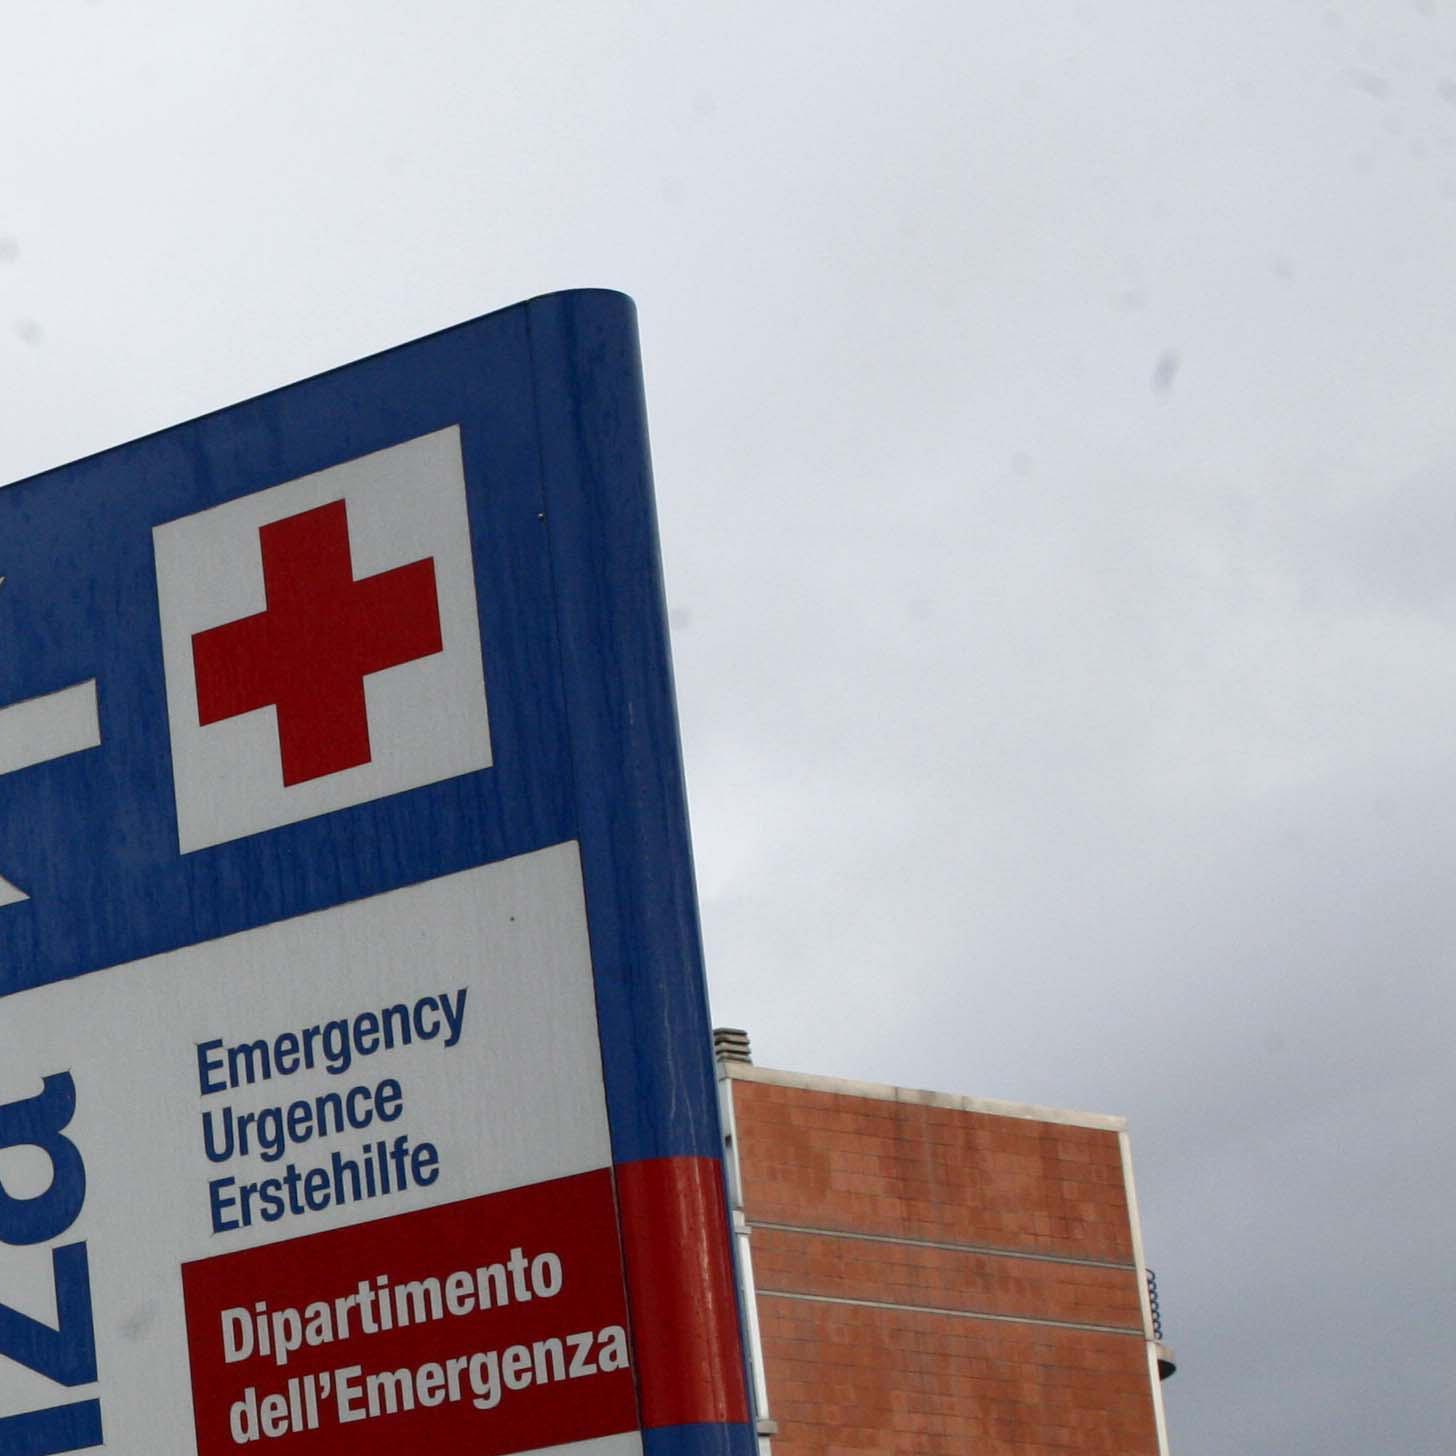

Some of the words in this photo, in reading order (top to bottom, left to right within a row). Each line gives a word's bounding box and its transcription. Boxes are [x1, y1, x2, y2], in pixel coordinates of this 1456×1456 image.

[197, 987, 468, 1095] Emergency
[201, 1077, 404, 1163] Urgence
[208, 1134, 440, 1234] Erstehilfe
[220, 1247, 564, 1366] Dipartimento
[229, 1324, 630, 1446] dell'Emergenza
